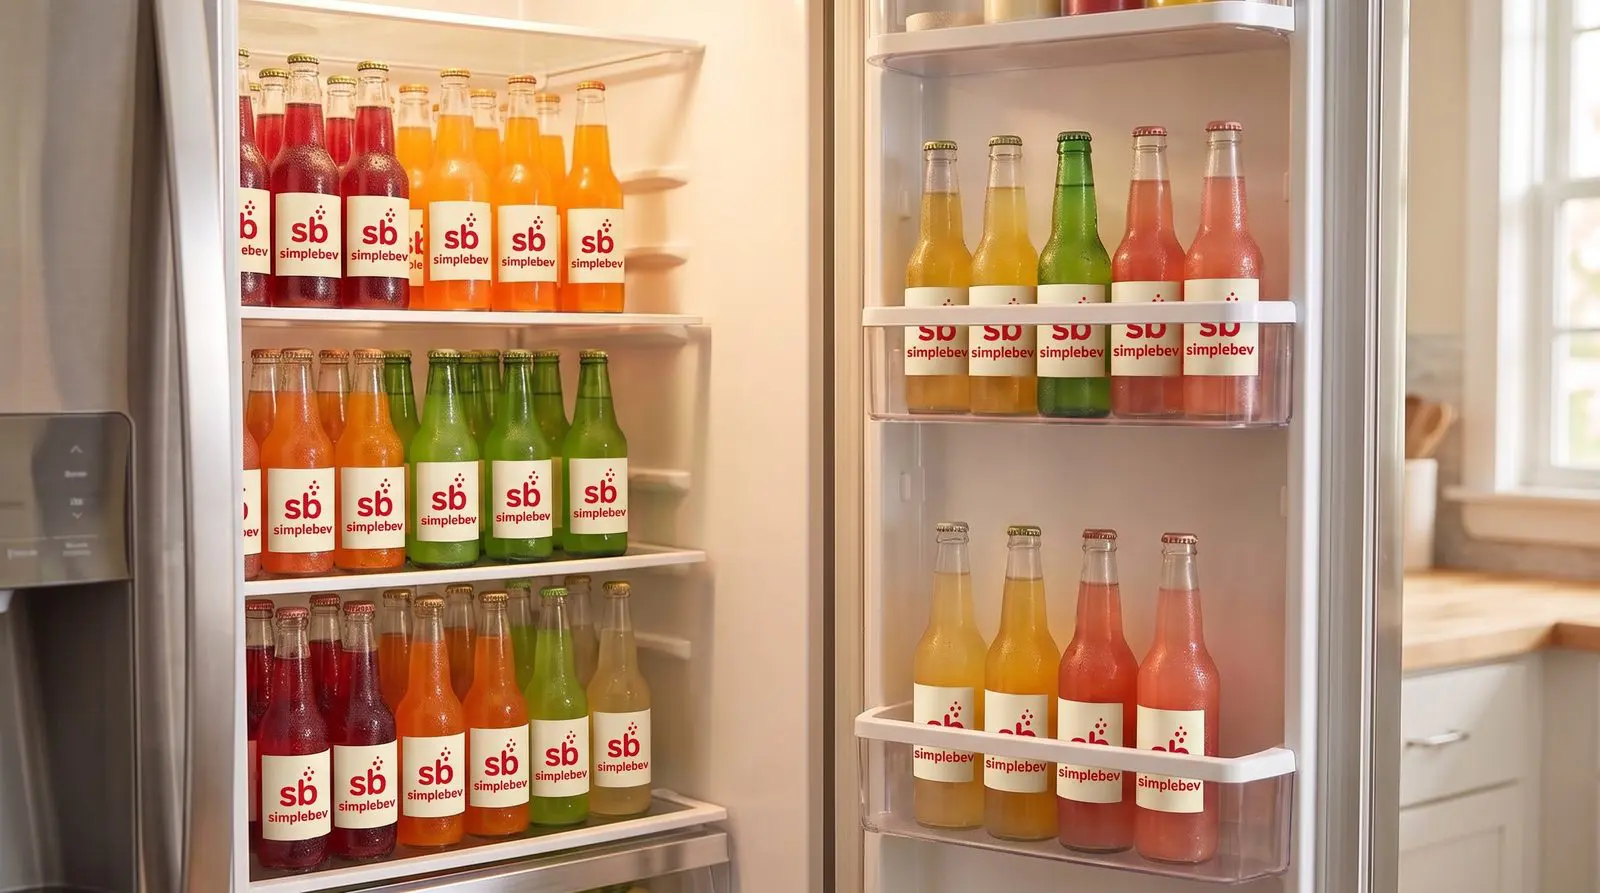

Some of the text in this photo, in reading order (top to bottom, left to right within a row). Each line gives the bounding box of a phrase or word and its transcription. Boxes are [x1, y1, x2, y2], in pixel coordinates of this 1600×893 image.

[291, 216, 328, 243] sb
[363, 219, 397, 245] sb
[445, 224, 478, 249] sb
[512, 227, 546, 252] sb
[582, 230, 614, 253] sb
[280, 248, 338, 259] simplebev
[351, 250, 408, 262] simplebev
[433, 254, 488, 266] simplebev
[502, 257, 555, 268] simplebev
[571, 259, 623, 270] simplebev
[907, 347, 968, 360] simplebev
[972, 347, 1034, 360] simplebev
[1040, 346, 1104, 360] simplebev
[1114, 345, 1179, 359] simplebev
[1187, 343, 1253, 358] simplebev
[432, 485, 466, 510] sb
[507, 482, 541, 507] sb
[585, 480, 617, 503] sb
[285, 492, 321, 519] sb
[358, 490, 393, 516] sb
[421, 515, 476, 527] simplebev
[496, 512, 550, 524] simplebev
[573, 508, 626, 519] simplebev
[274, 524, 332, 537] simplebev
[346, 522, 403, 534] simplebev
[608, 734, 640, 758] sb
[545, 742, 578, 766] sb
[915, 748, 974, 764] simplebev
[485, 750, 518, 776] sb
[598, 762, 648, 773] simplebev
[986, 758, 1046, 773] simplebev
[419, 759, 453, 785] sb
[535, 771, 587, 783] simplebev
[1059, 767, 1120, 783] simplebev
[350, 769, 386, 796] sb
[474, 779, 527, 793] simplebev
[1139, 776, 1200, 792] simplebev
[280, 779, 317, 807] sb
[408, 788, 462, 802] simplebev
[339, 799, 395, 813] simplebev
[269, 810, 328, 824] simplebev
